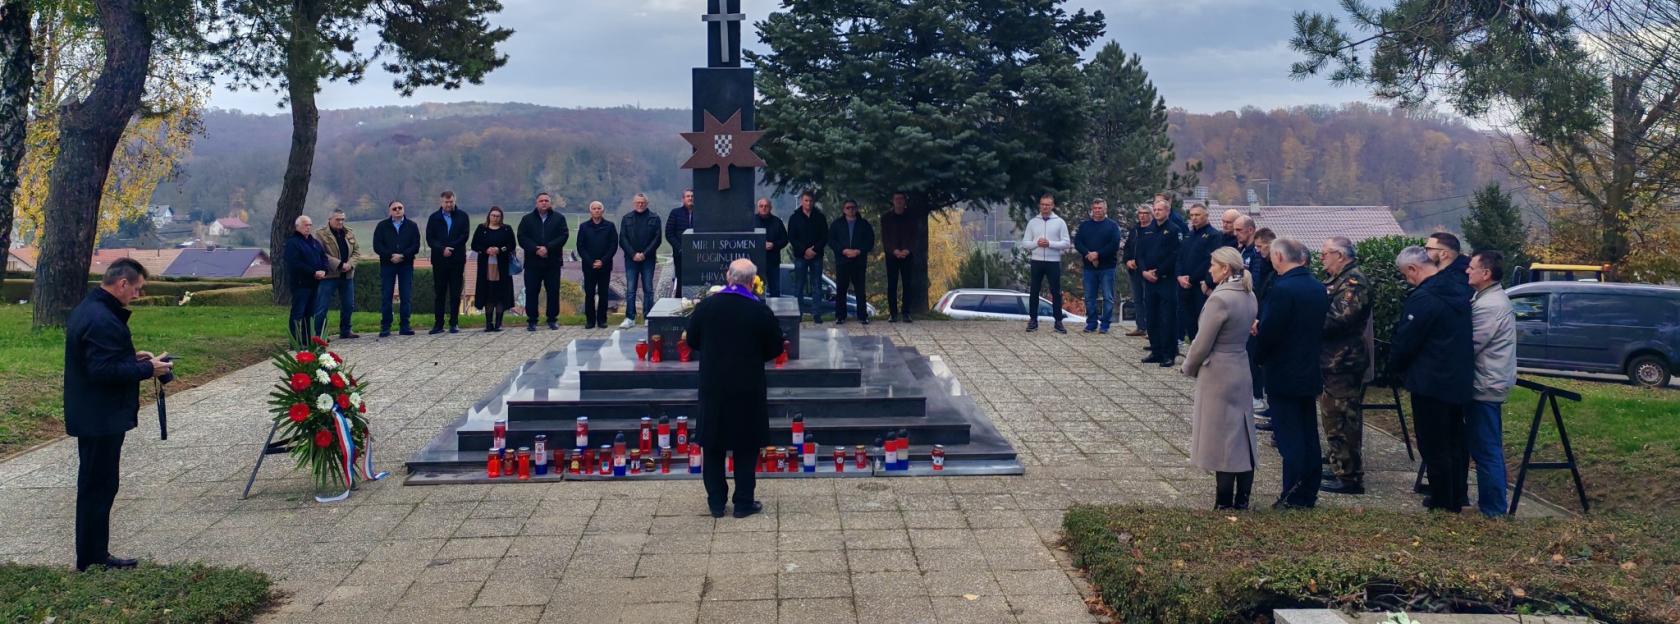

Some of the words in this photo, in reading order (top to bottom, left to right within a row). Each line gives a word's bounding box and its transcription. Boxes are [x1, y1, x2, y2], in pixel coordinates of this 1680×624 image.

[692, 240, 708, 250] MIR
[719, 240, 756, 249] SPOMEN
[701, 272, 726, 281] HRVA
